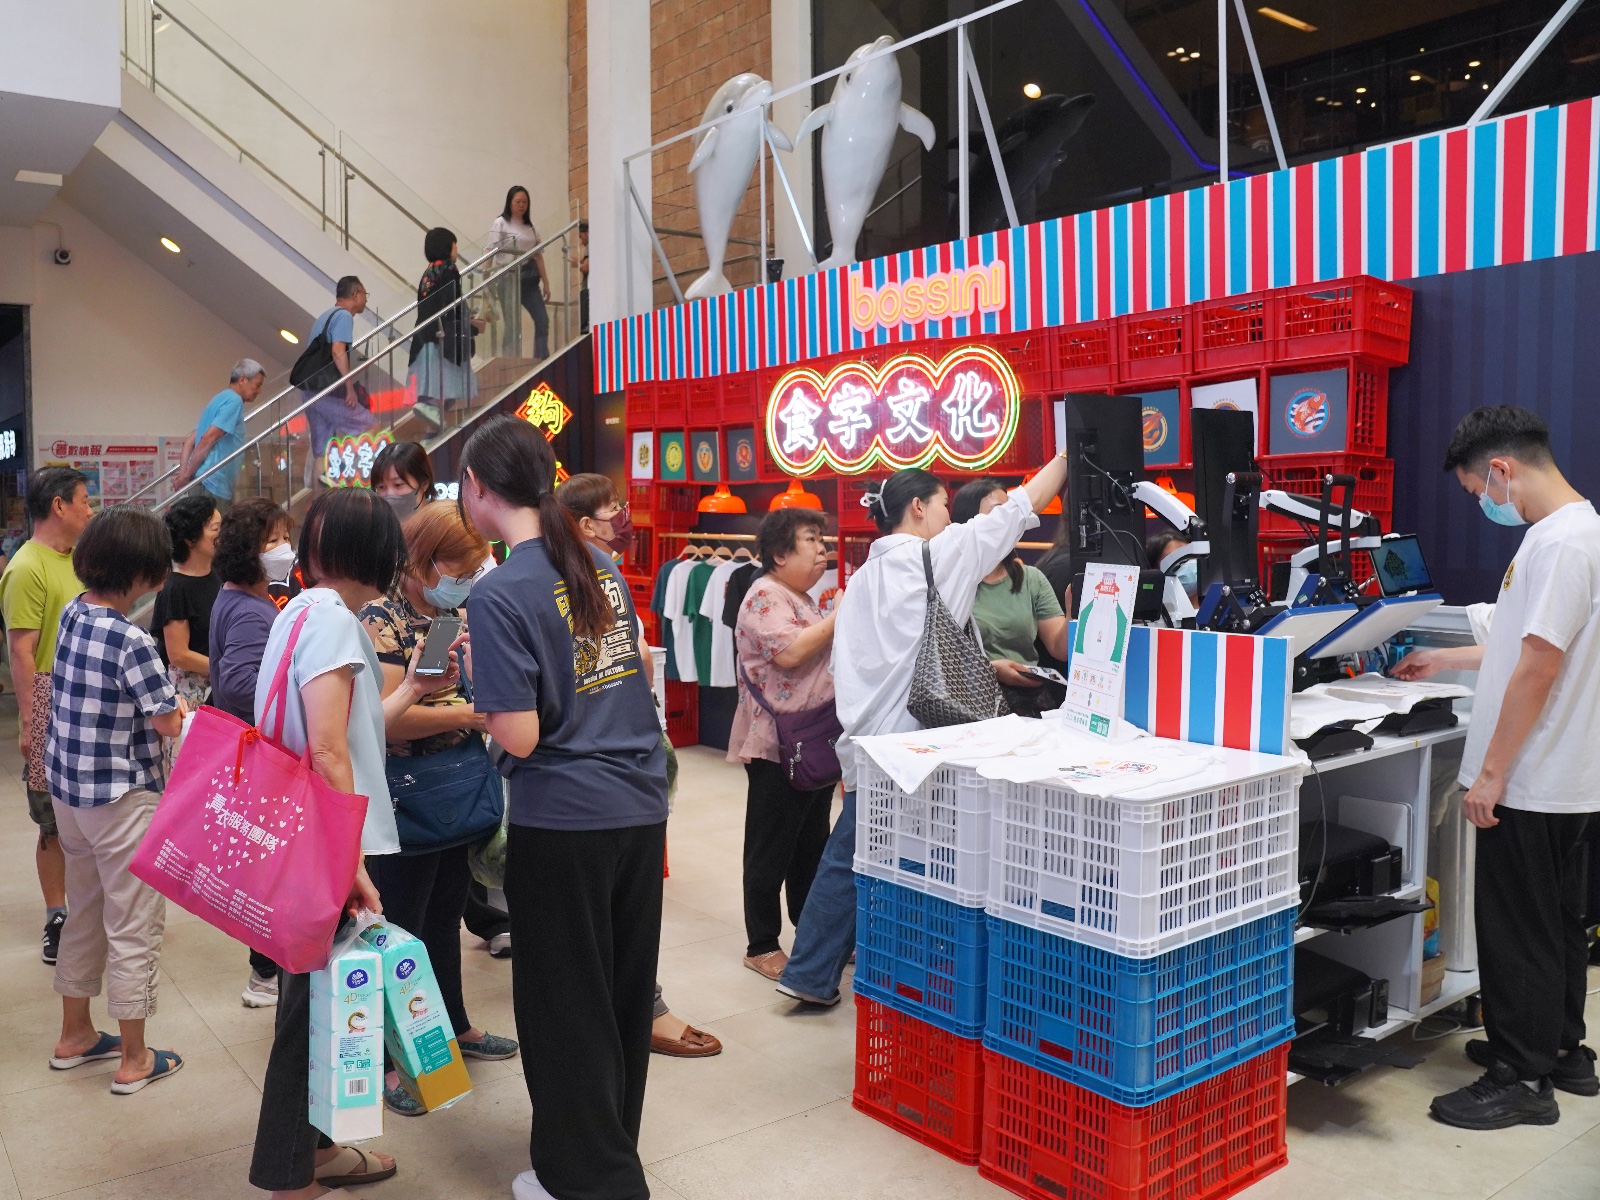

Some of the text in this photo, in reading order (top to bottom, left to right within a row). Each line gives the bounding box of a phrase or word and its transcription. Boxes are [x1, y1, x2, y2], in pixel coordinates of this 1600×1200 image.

[850, 262, 1005, 331] bossini
[778, 371, 1000, 454] 食字文化
